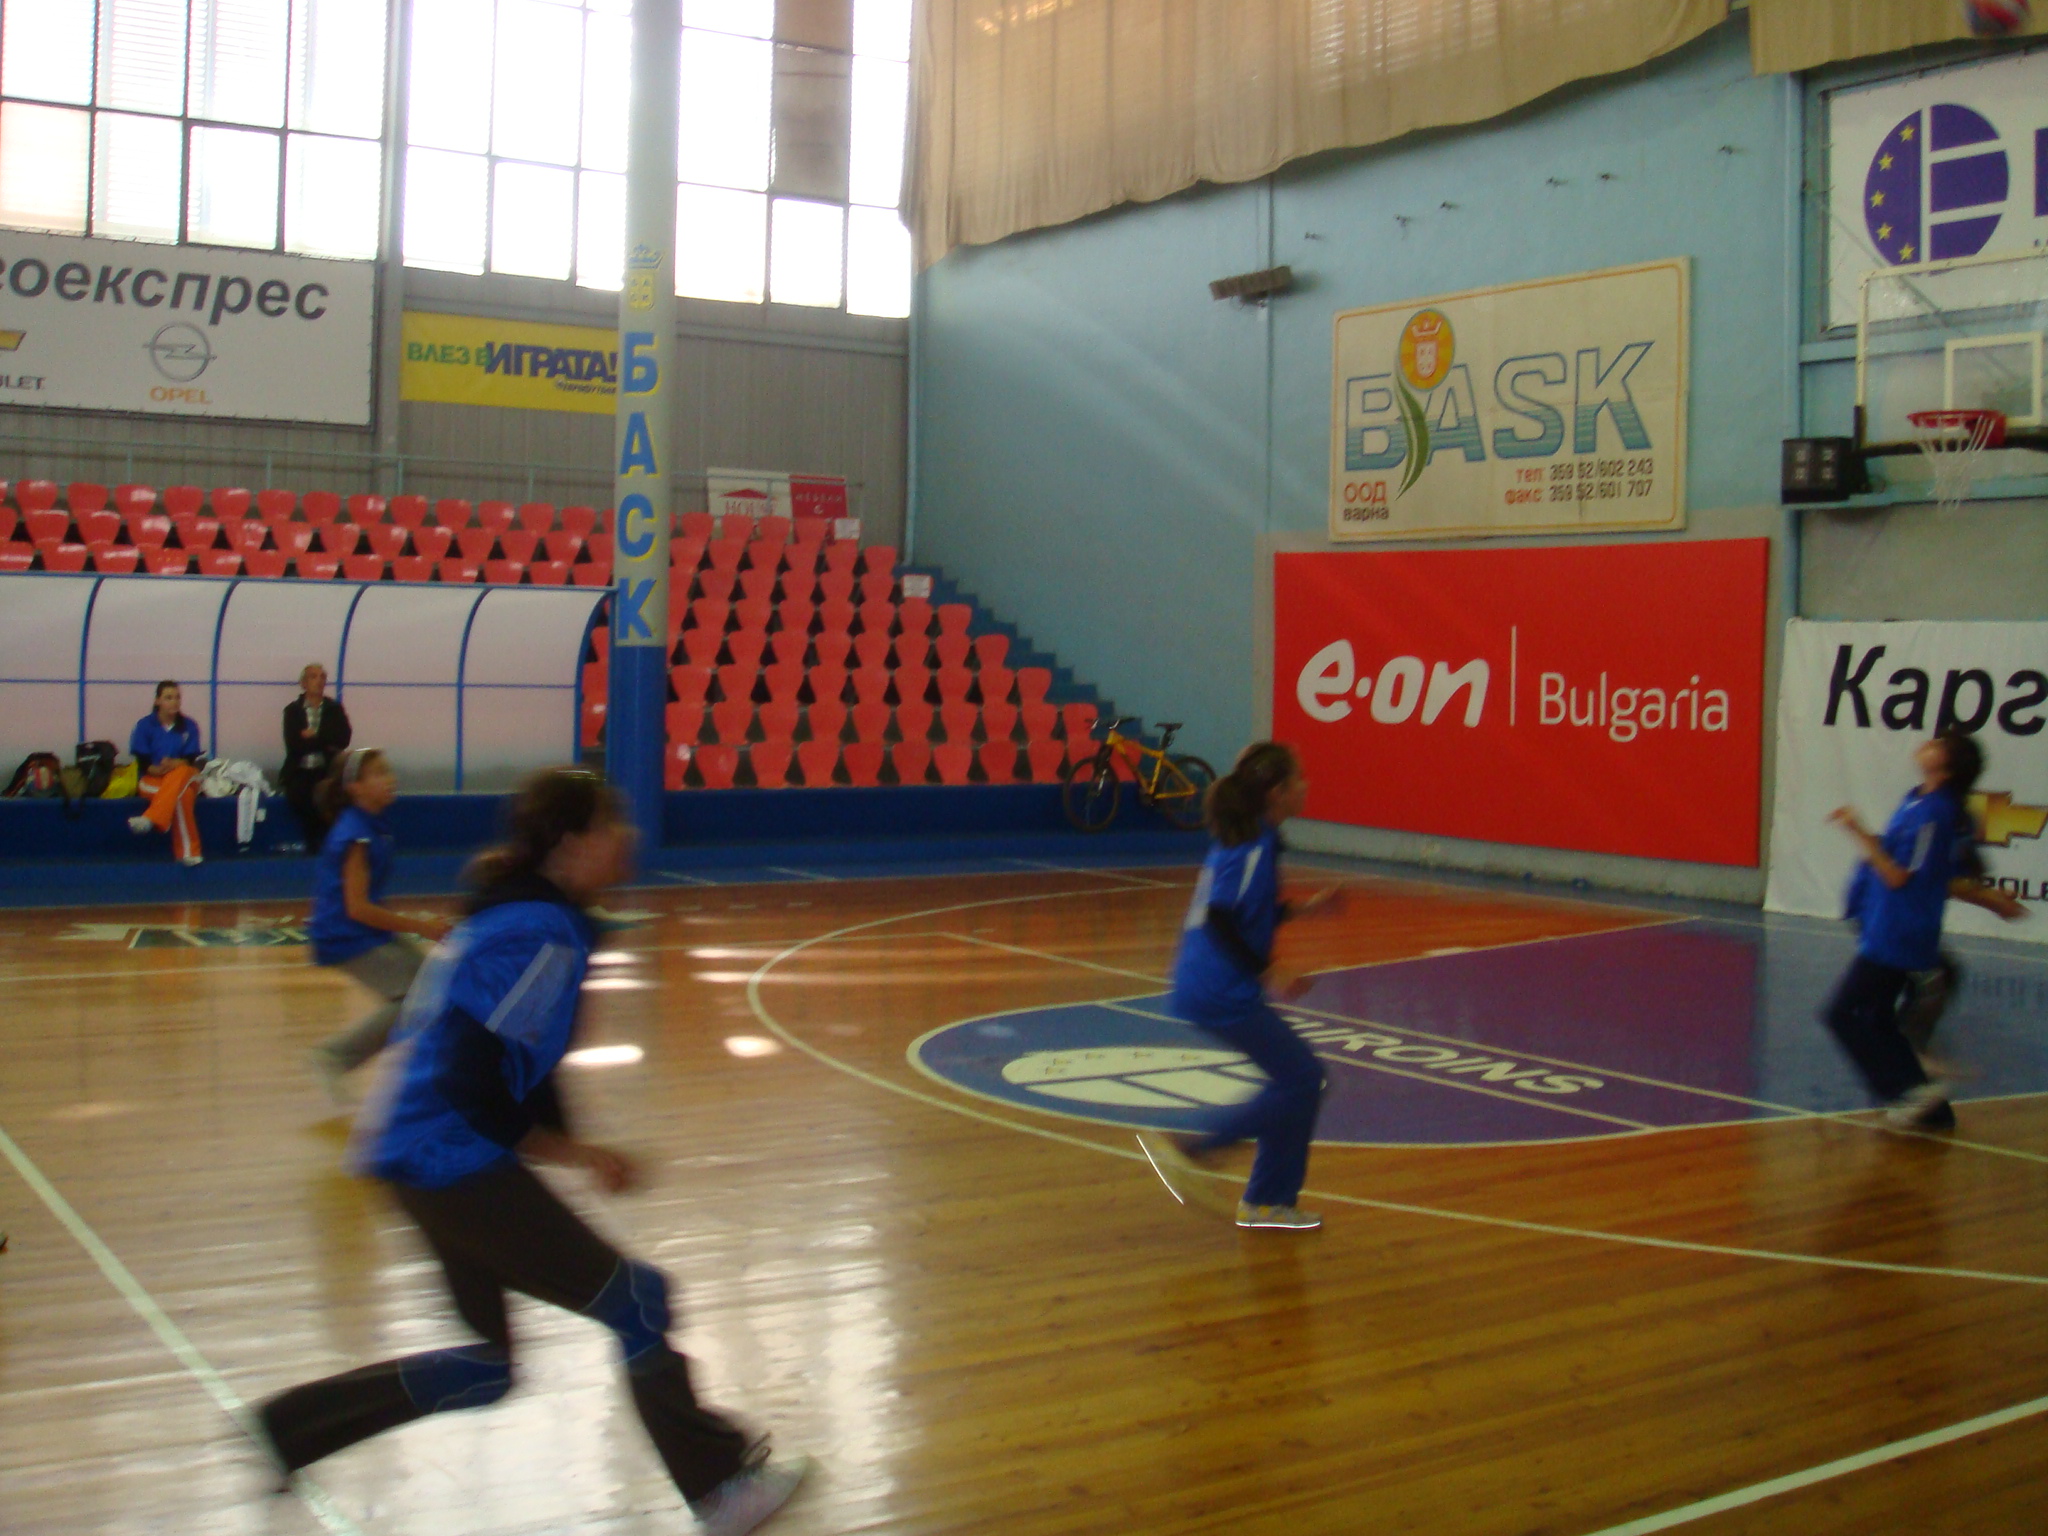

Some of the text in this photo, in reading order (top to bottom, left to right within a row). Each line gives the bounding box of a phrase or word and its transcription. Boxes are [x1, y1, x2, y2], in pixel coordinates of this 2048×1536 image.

[149, 385, 213, 405] OPEL
[1345, 340, 1655, 472] BASK
[616, 331, 660, 640] БАСК
[1343, 480, 1388, 506] ООД
[1627, 478, 1654, 499] 707
[1538, 671, 1730, 743] Bulgaria
